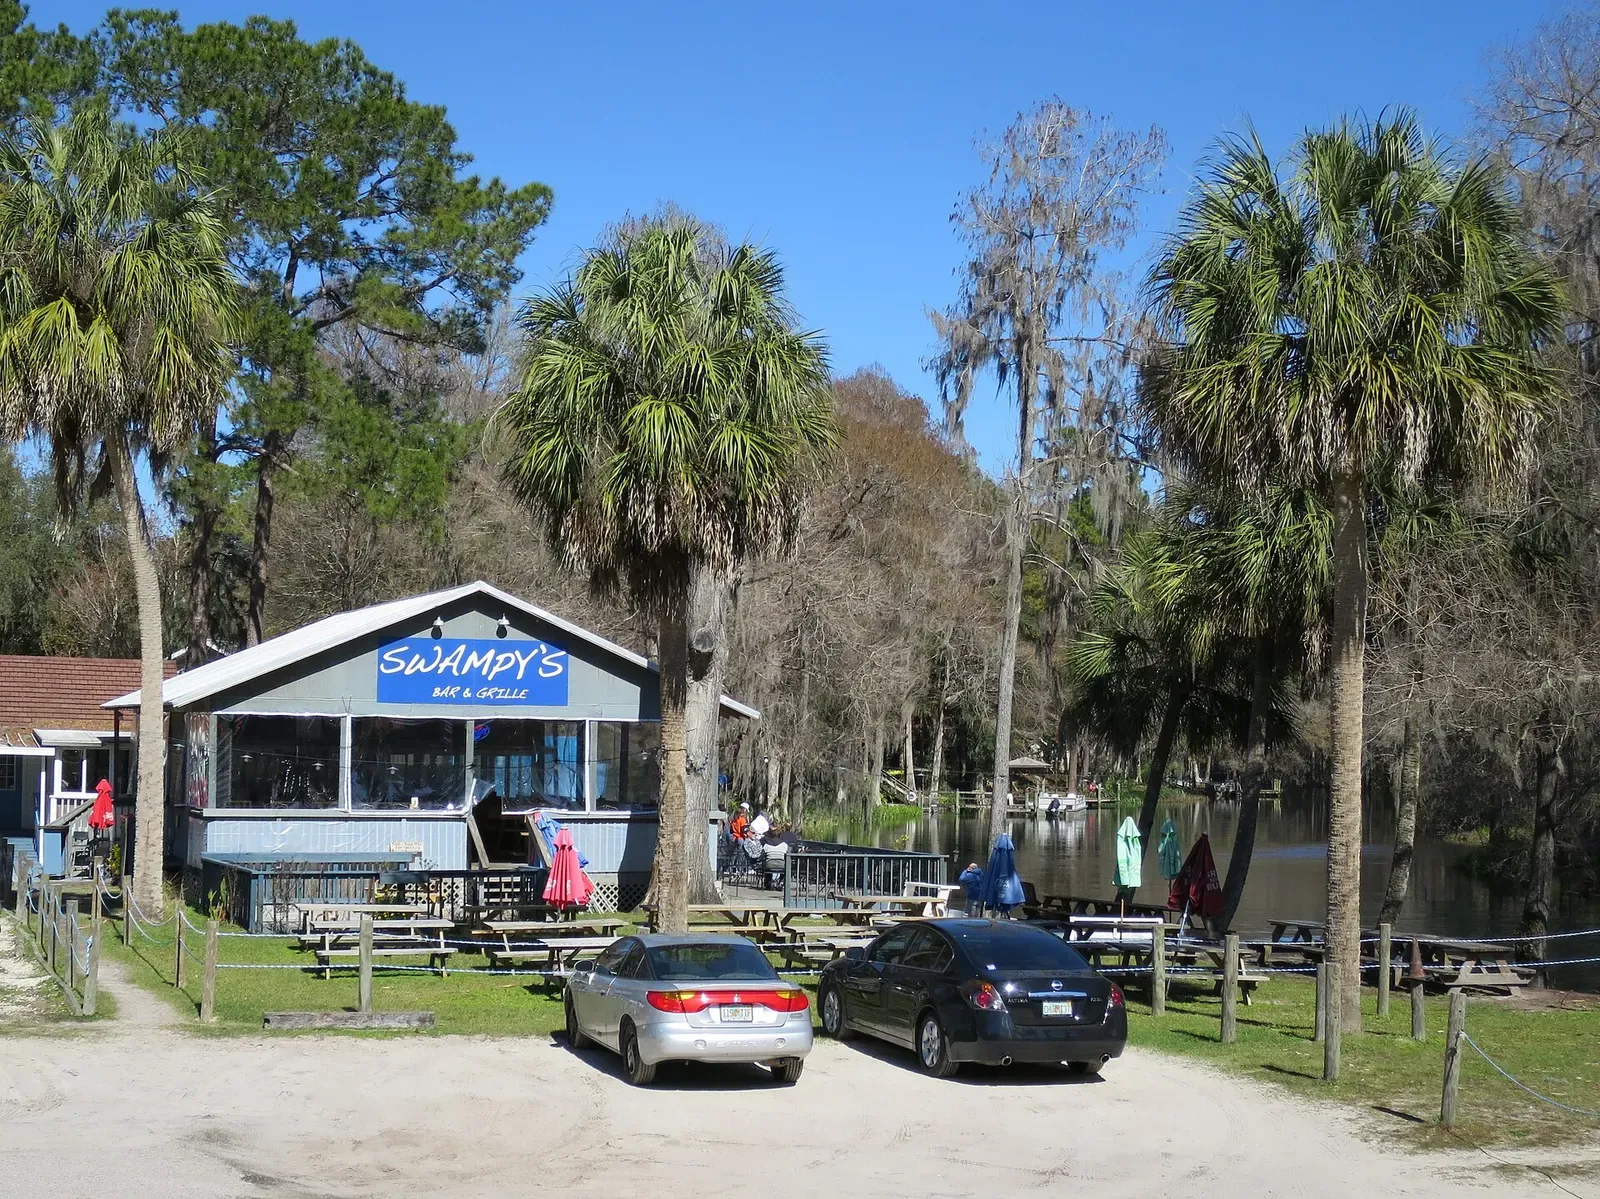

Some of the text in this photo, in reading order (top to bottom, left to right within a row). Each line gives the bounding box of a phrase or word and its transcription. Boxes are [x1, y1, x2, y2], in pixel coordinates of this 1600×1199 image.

[379, 643, 567, 681] SWAMPY'S
[432, 686, 529, 700] BAR & GRILLE
